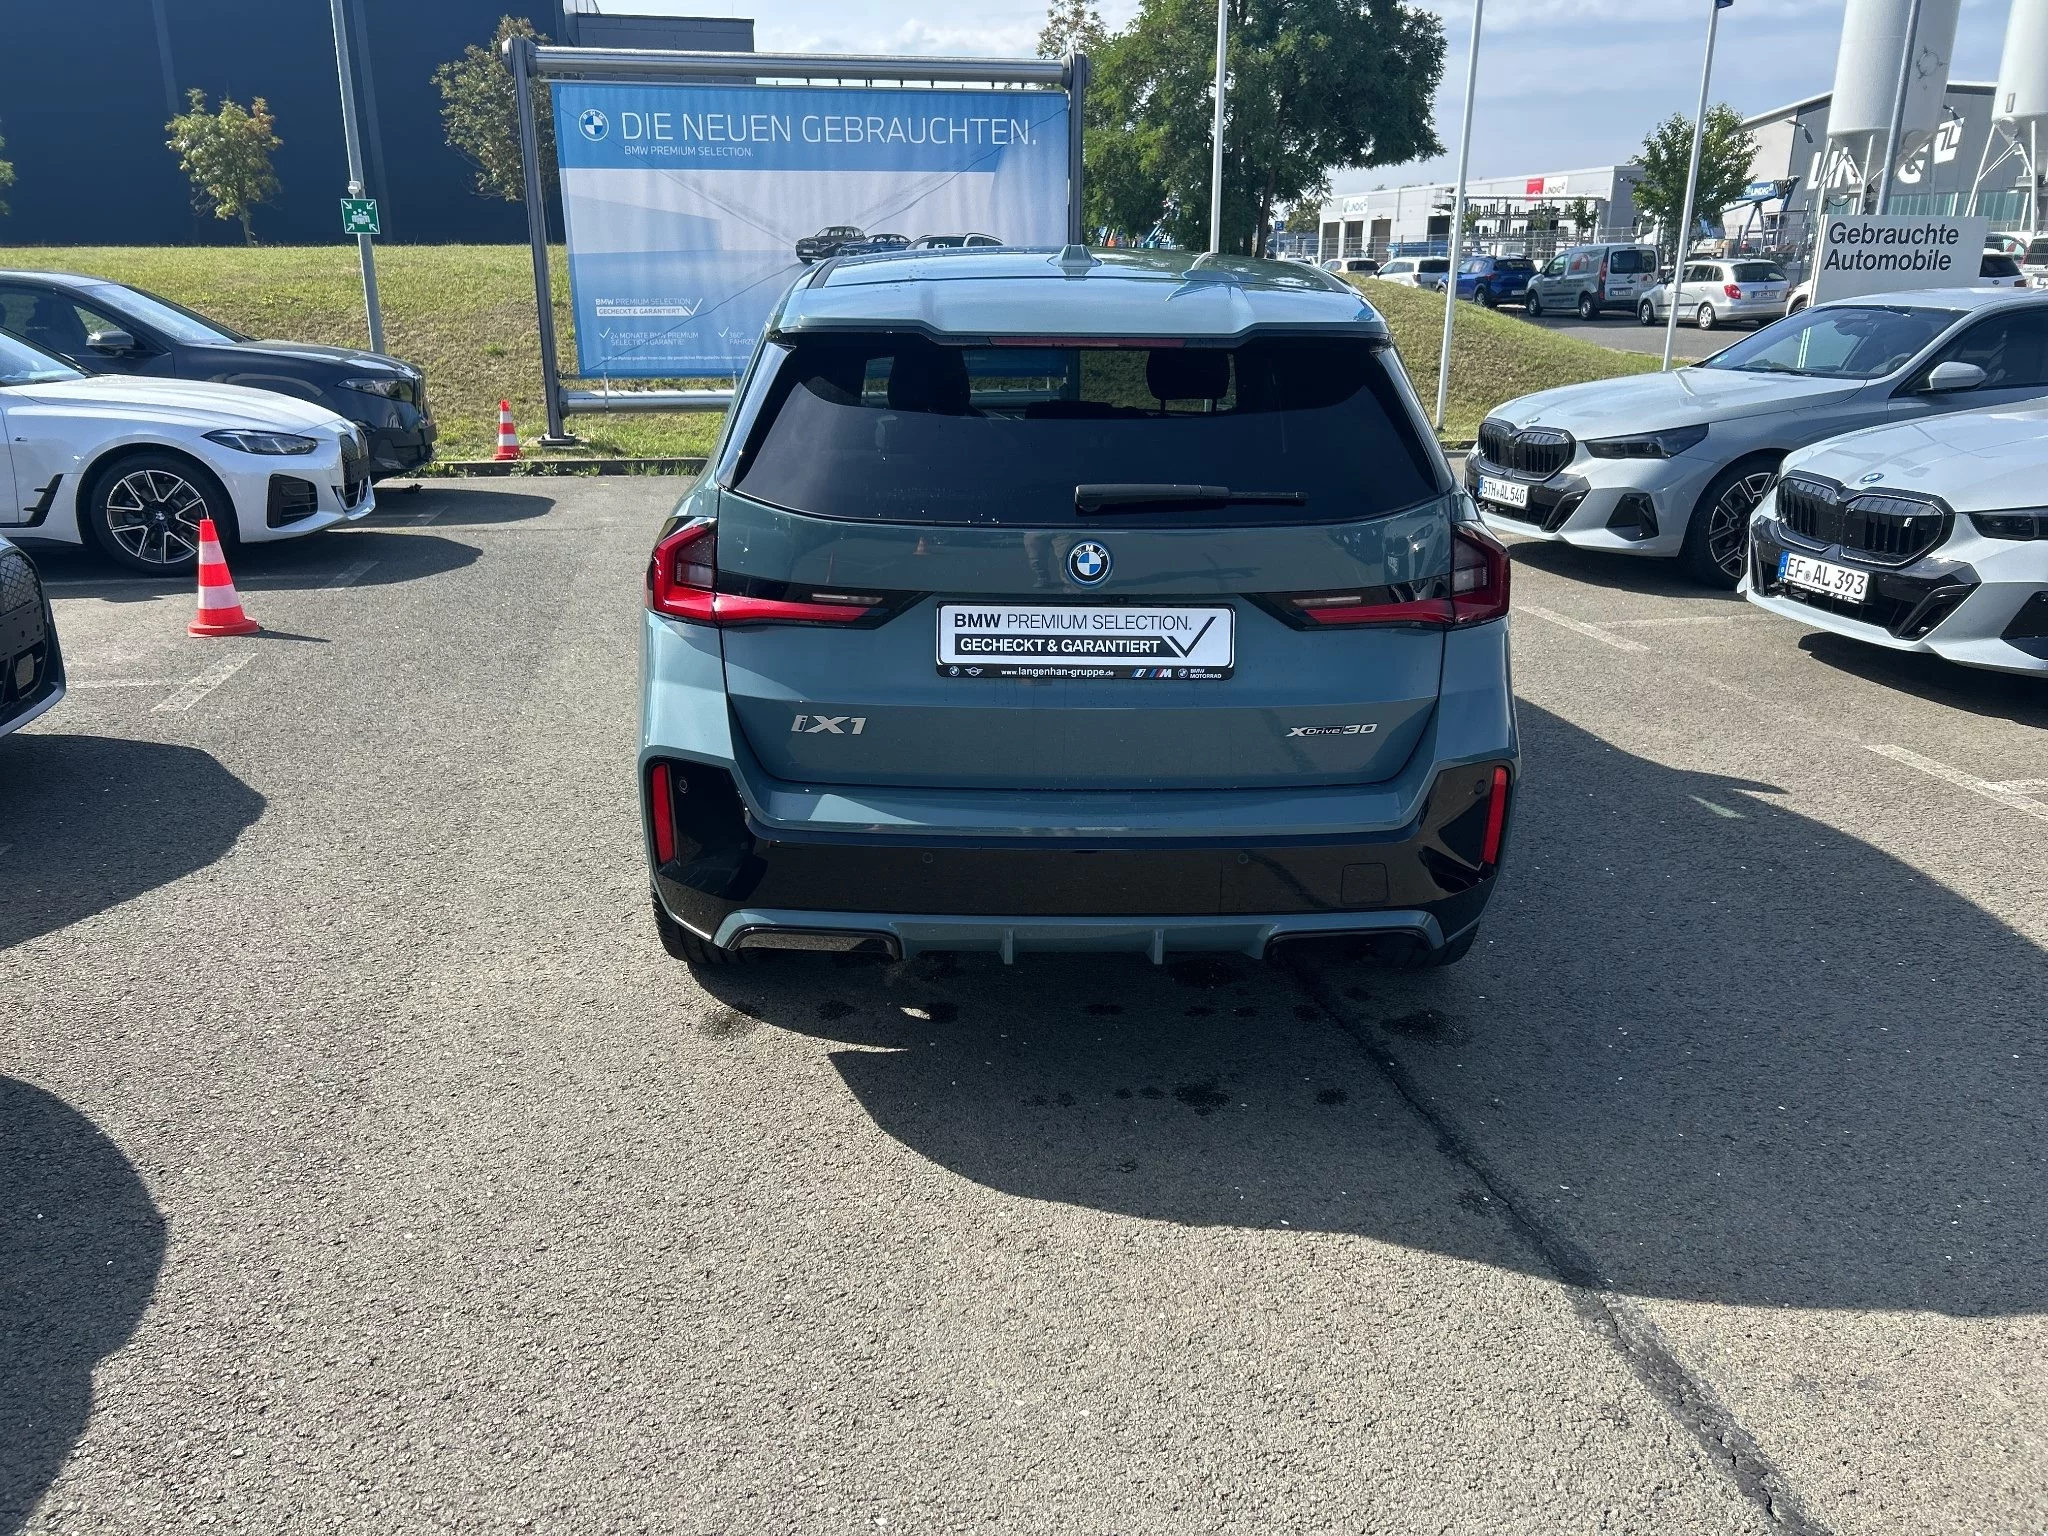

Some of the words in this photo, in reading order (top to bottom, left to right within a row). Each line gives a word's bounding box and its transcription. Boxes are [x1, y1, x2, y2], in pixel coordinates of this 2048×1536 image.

[621, 112, 673, 140] DIE
[682, 113, 791, 142] NEUEN
[802, 115, 1037, 145] GEBRAUCHTEN.
[624, 145, 648, 155] BMW
[650, 146, 696, 156] PREMIUM
[697, 146, 754, 157] SELECTION.
[1829, 221, 1959, 245] Gebrauchte
[1823, 249, 1952, 271] Automobile
[615, 298, 649, 306] PREMIUM
[1499, 484, 1508, 500] AL
[1510, 487, 1525, 504] 540
[1786, 557, 1806, 578] EF
[1812, 564, 1831, 587] AL
[1834, 569, 1866, 595] 393
[954, 613, 1002, 628] BMW
[1007, 613, 1087, 629] PREMIUM
[1092, 614, 1192, 631] SELECTION.
[960, 638, 1045, 652] GECHECKT
[1047, 639, 1058, 652] &
[1061, 639, 1160, 653] GARANTIERT
[1001, 666, 1114, 678] www.langenhan-gruppe.de
